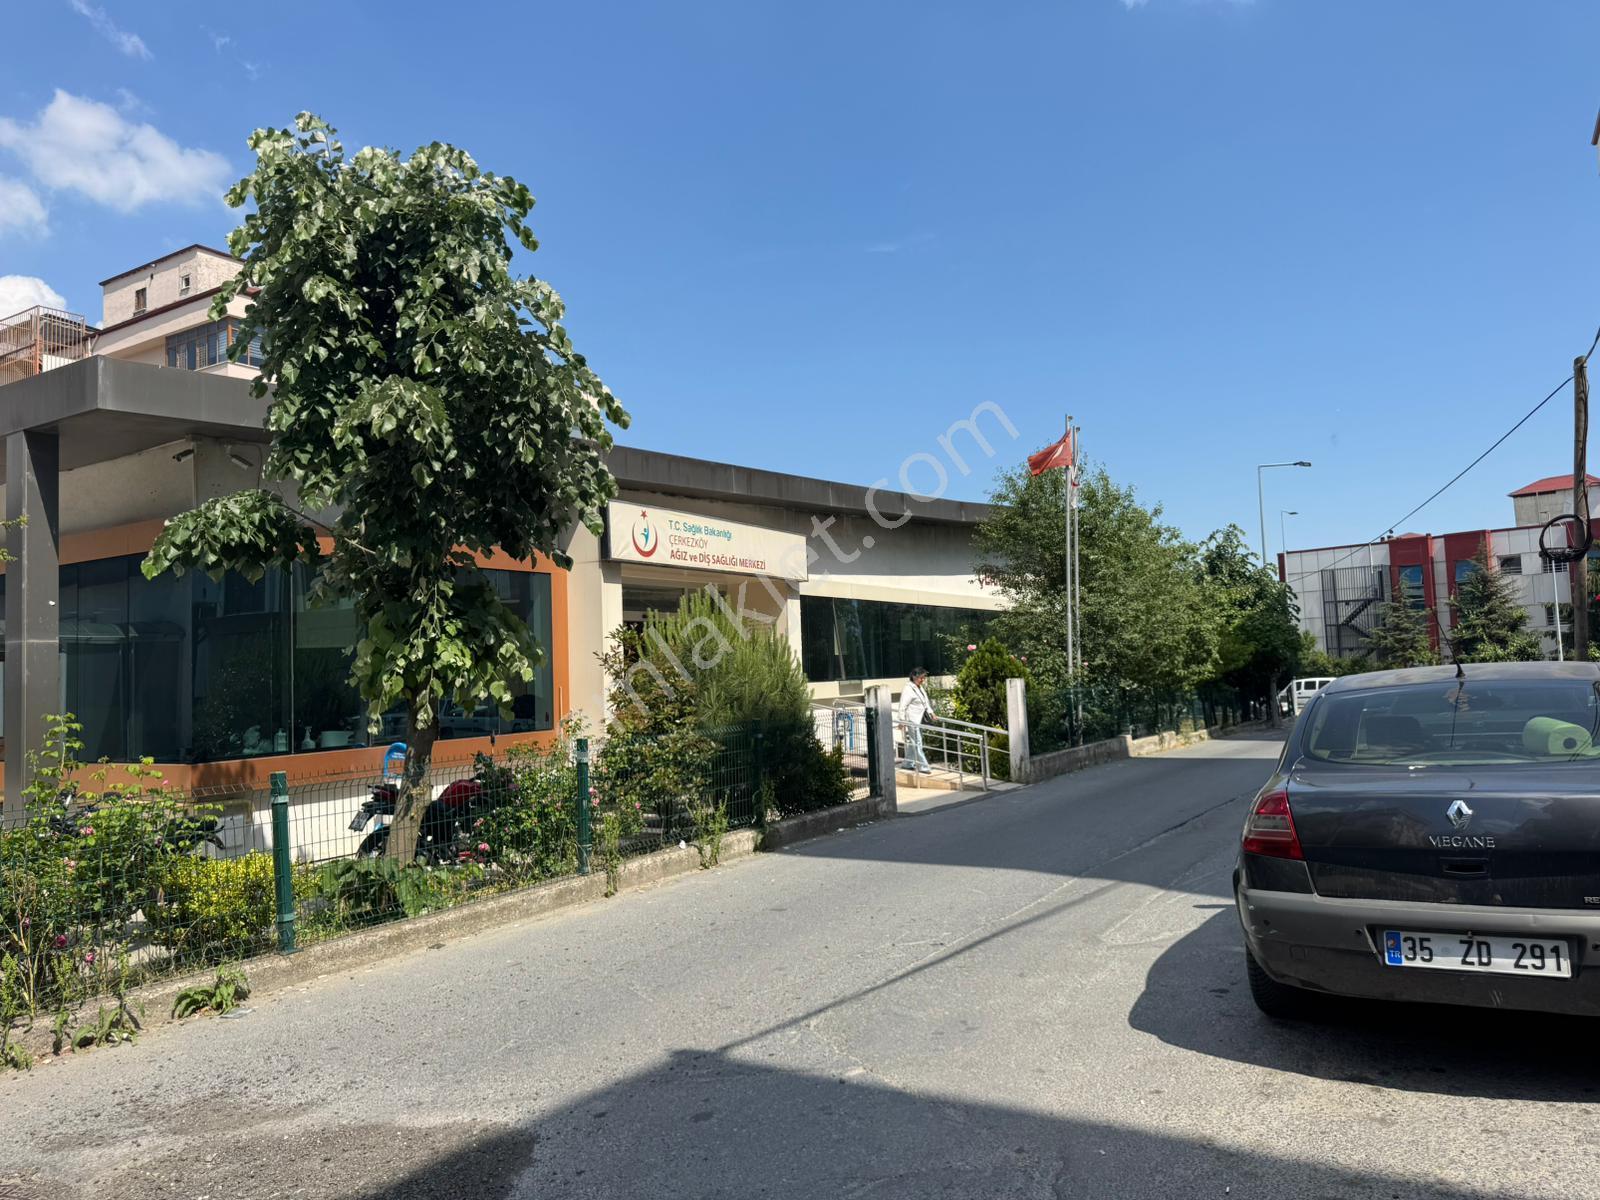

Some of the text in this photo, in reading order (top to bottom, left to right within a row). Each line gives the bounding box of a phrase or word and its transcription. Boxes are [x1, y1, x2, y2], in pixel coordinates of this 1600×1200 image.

[682, 521, 703, 536] Sağlık
[703, 525, 732, 541] Bakanlığı
[669, 534, 708, 549] ÇERKEZKÖY
[670, 548, 766, 570] AĞIZ ve DİŞ SAĞLIĞI MERKEZİ
[1429, 835, 1496, 848] MEGANE
[1389, 936, 1562, 972] TR 35 ZD 291
